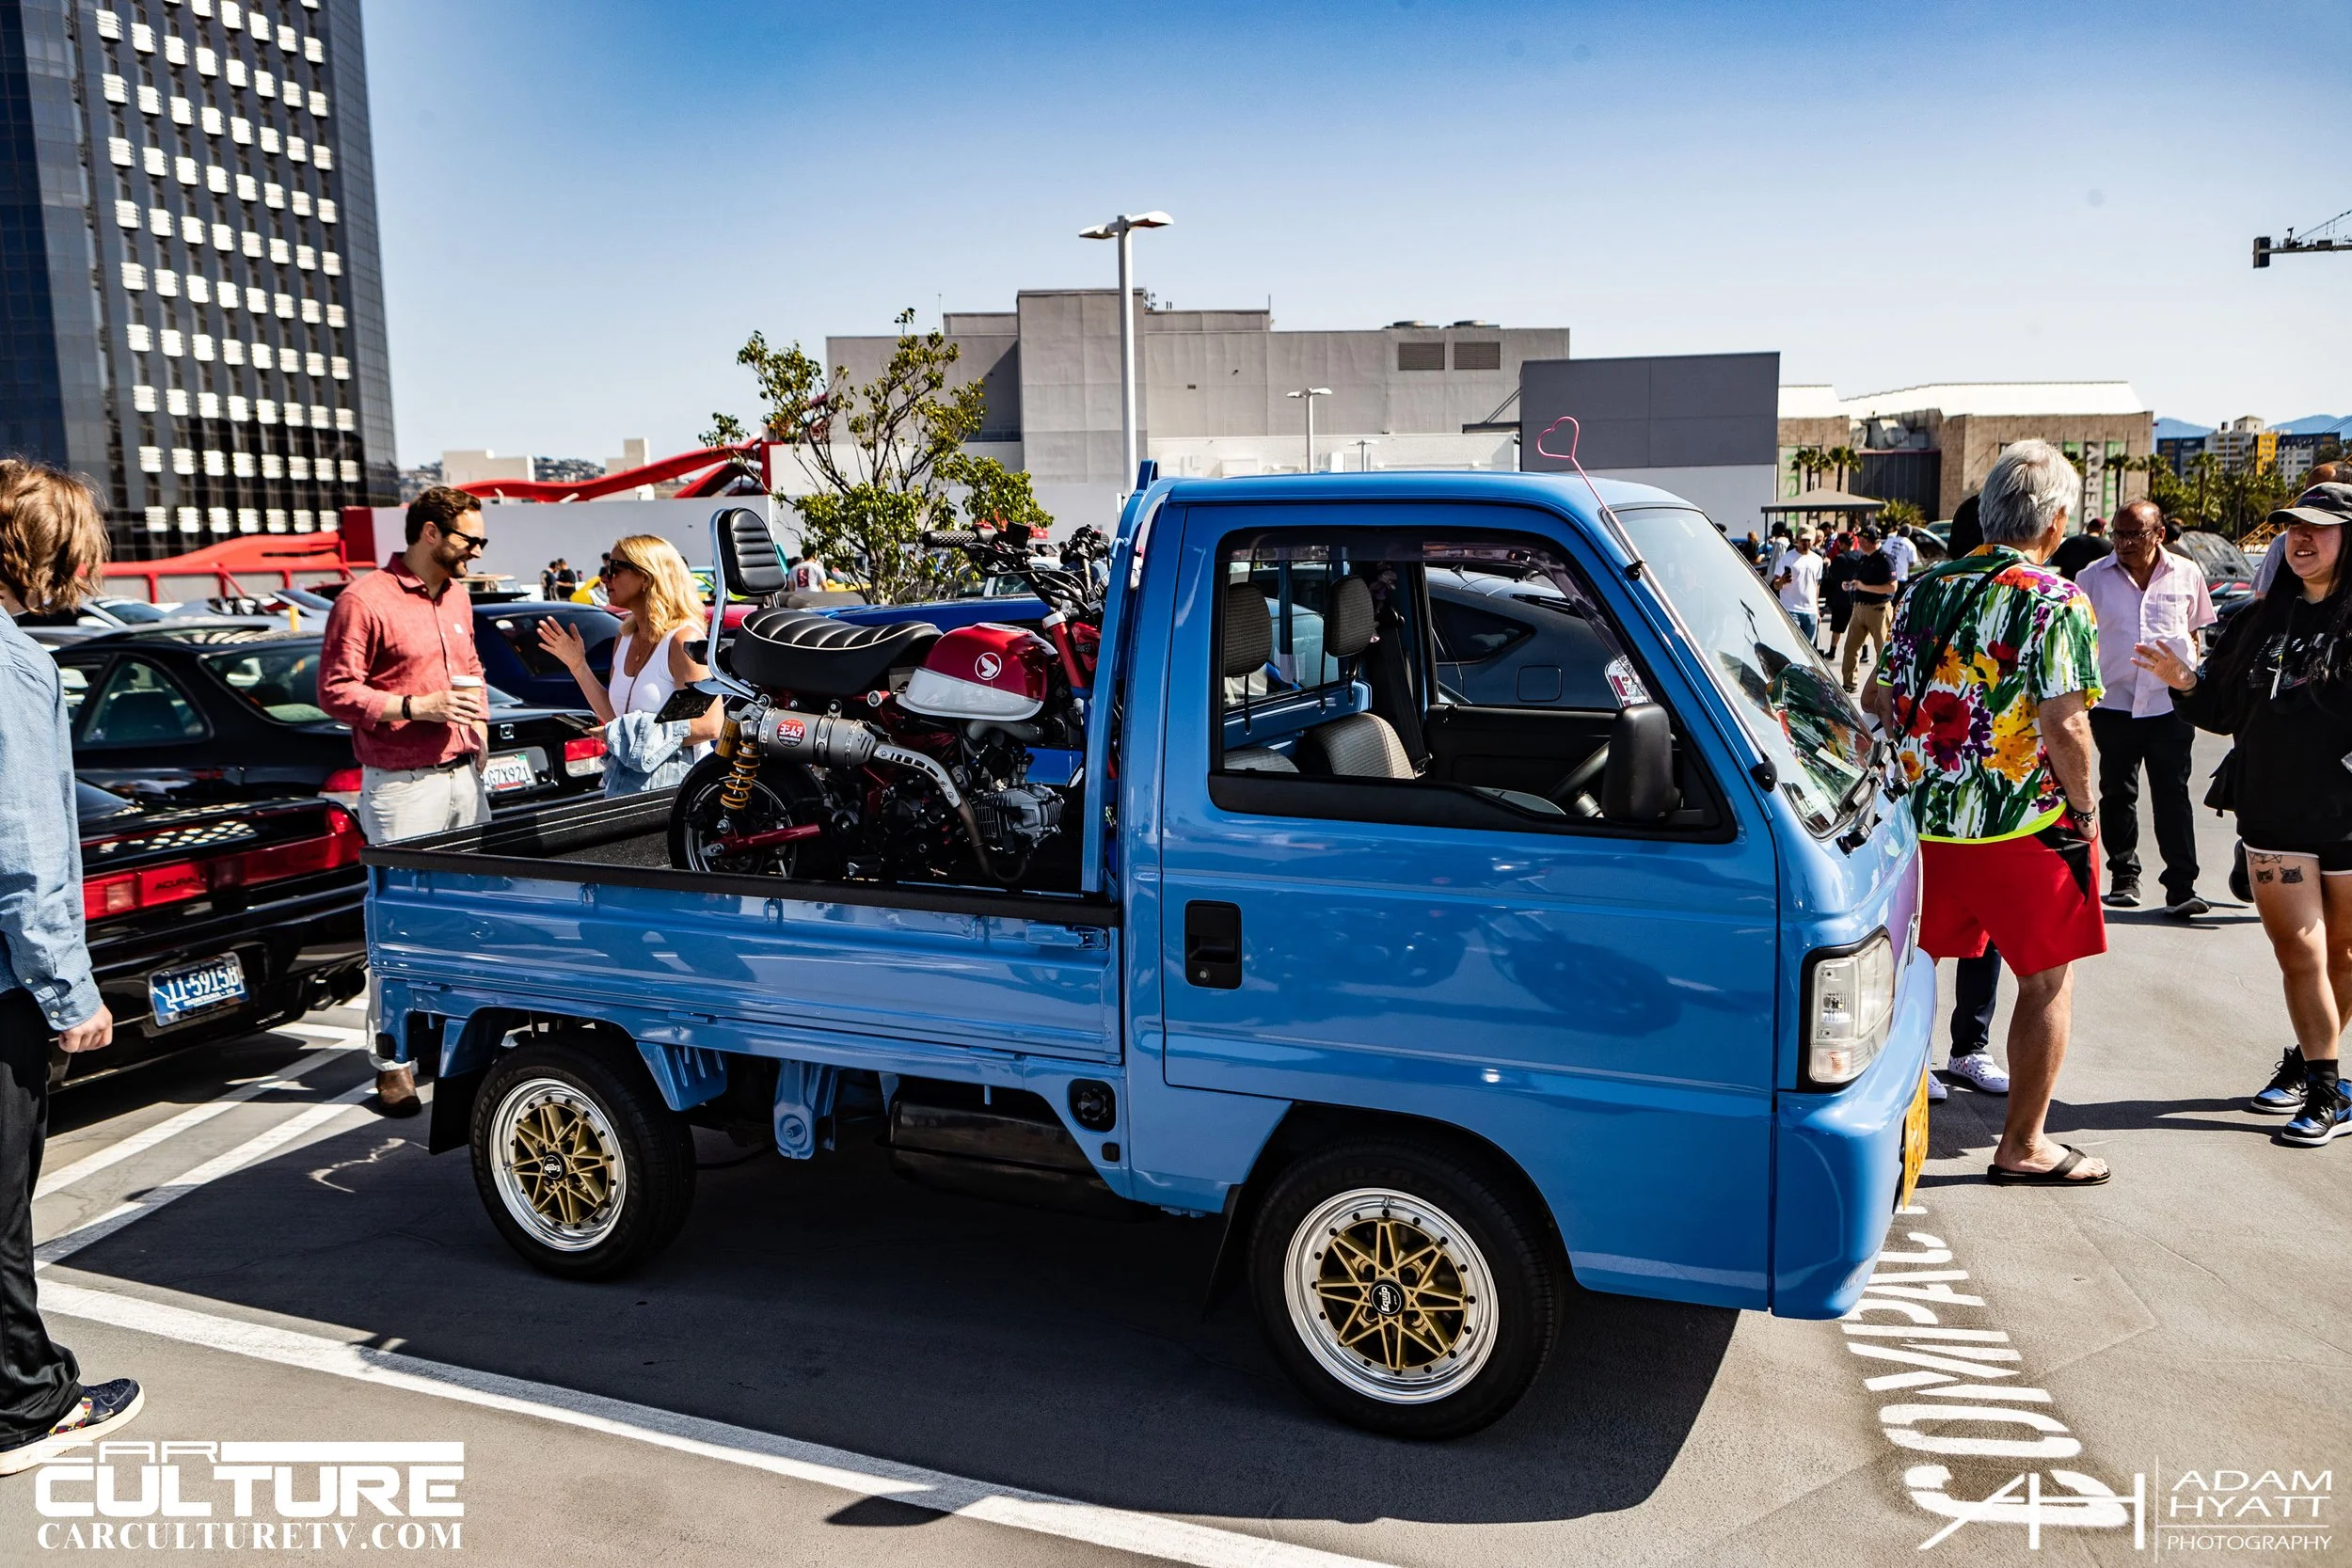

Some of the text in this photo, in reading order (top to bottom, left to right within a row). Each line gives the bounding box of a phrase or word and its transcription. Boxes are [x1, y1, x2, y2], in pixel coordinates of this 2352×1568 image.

[2083, 442, 2104, 524] PERTY
[485, 766, 531, 787] GZX921
[154, 876, 197, 891] ACURA
[1378, 1286, 1391, 1313] Equip
[1839, 1204, 2129, 1528] COMPAC
